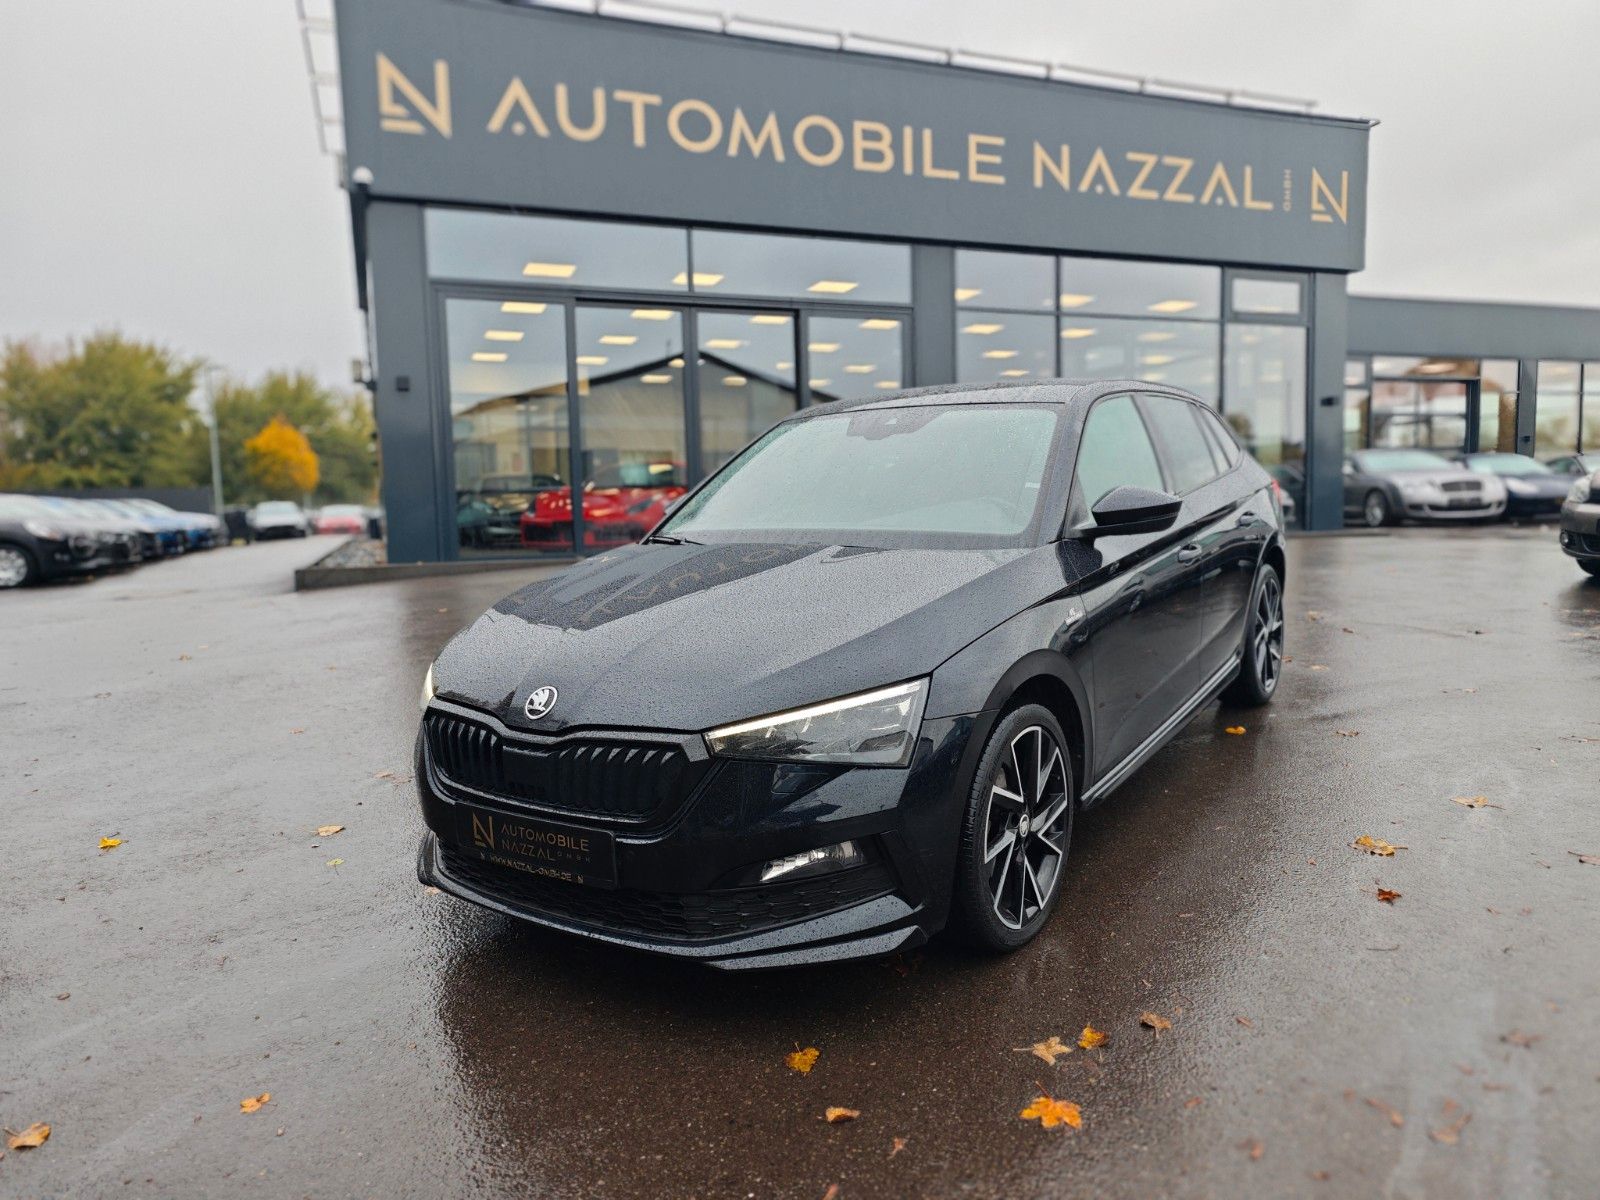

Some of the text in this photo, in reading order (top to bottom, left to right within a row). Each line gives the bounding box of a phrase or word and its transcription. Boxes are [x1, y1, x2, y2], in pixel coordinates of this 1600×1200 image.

[487, 76, 1005, 185] AUTOMOBILE
[1033, 140, 1274, 212] NAZZAL
[501, 824, 590, 852] AUTOMOBILE
[502, 839, 556, 861] NAZZAL
